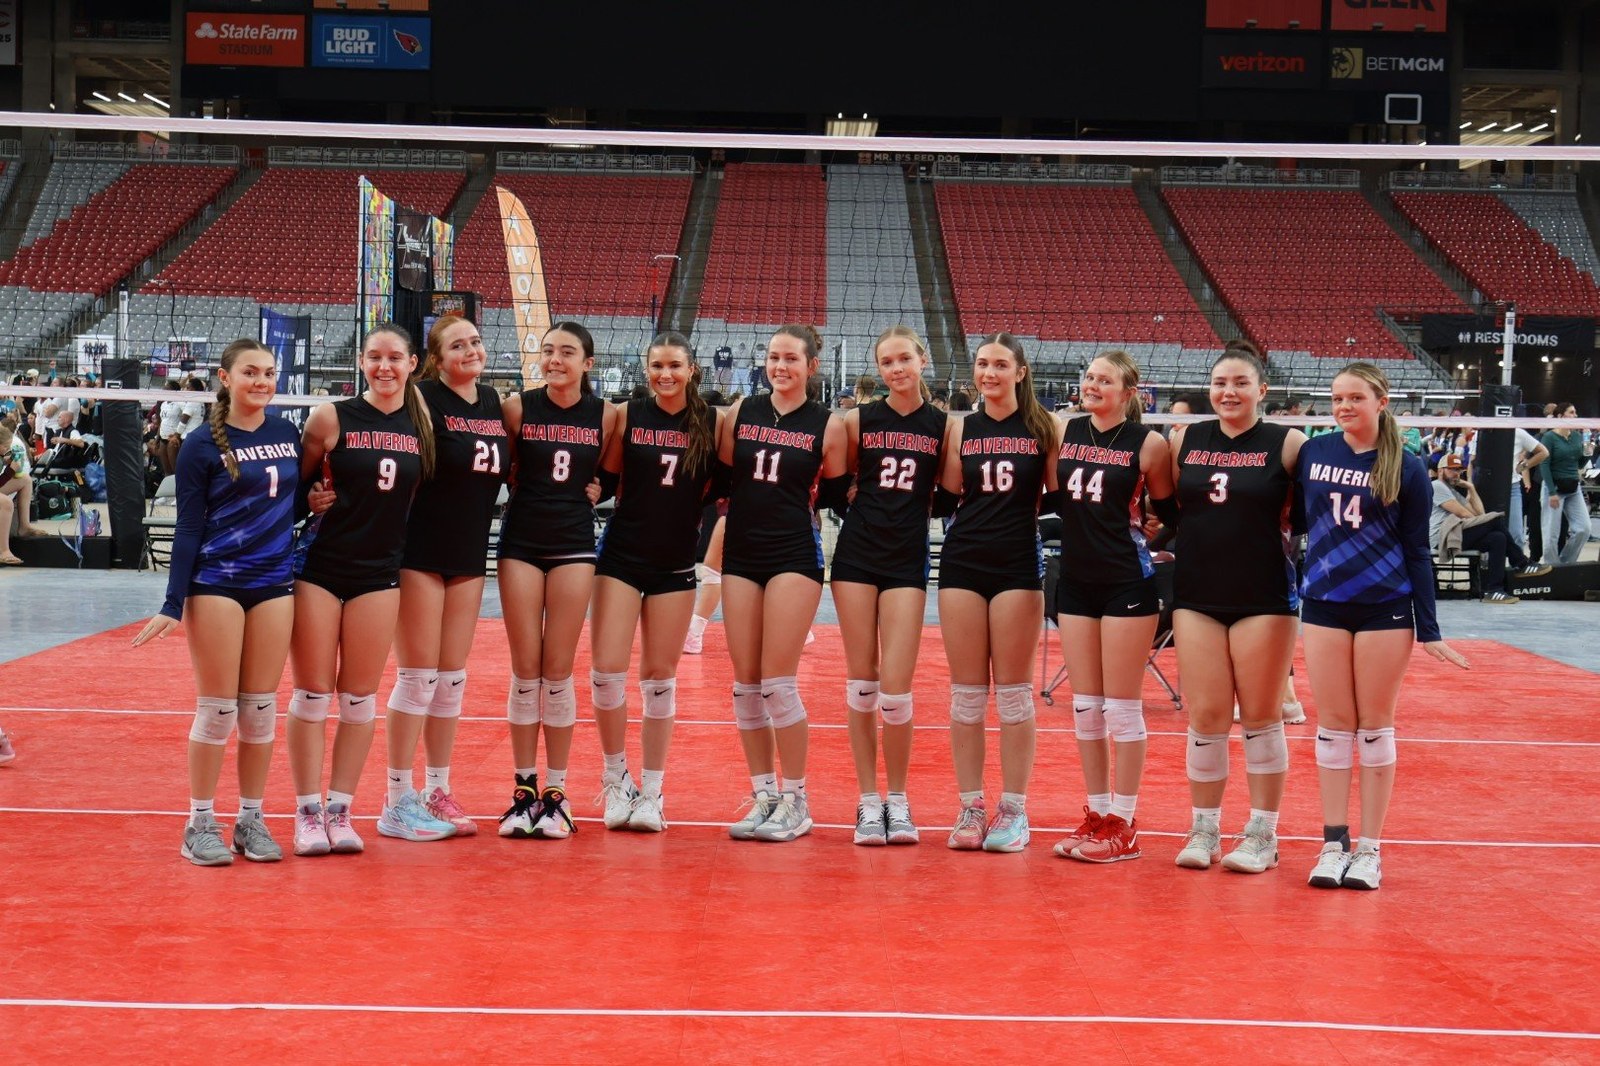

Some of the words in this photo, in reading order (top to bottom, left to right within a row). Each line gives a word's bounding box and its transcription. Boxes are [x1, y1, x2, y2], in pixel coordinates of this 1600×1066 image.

[333, 27, 370, 41] BUD
[218, 44, 273, 56] STADIUM
[325, 40, 376, 55] LIGHT
[1219, 52, 1305, 72] verizon
[1366, 57, 1444, 72] BETMGM
[937, 154, 960, 162] DOG
[444, 415, 507, 437] MAVERICK
[522, 423, 600, 446] MAVERICK
[631, 427, 690, 449] MAVERI
[738, 423, 816, 452] MAVERICK
[862, 431, 939, 456] MAVERICK
[961, 436, 1039, 456] MAVERICK
[472, 440, 501, 474] 21
[552, 450, 571, 482] 8
[752, 449, 782, 483] 11
[1184, 450, 1269, 468] MAVERICK
[265, 465, 279, 498] 1
[377, 458, 397, 491] 9
[661, 454, 678, 486] 7
[879, 456, 917, 491] 22
[981, 460, 1014, 492] 16
[1309, 463, 1374, 488] MAVERI
[1067, 467, 1105, 503] 44
[1209, 472, 1229, 504] 3
[1329, 491, 1363, 529] 14
